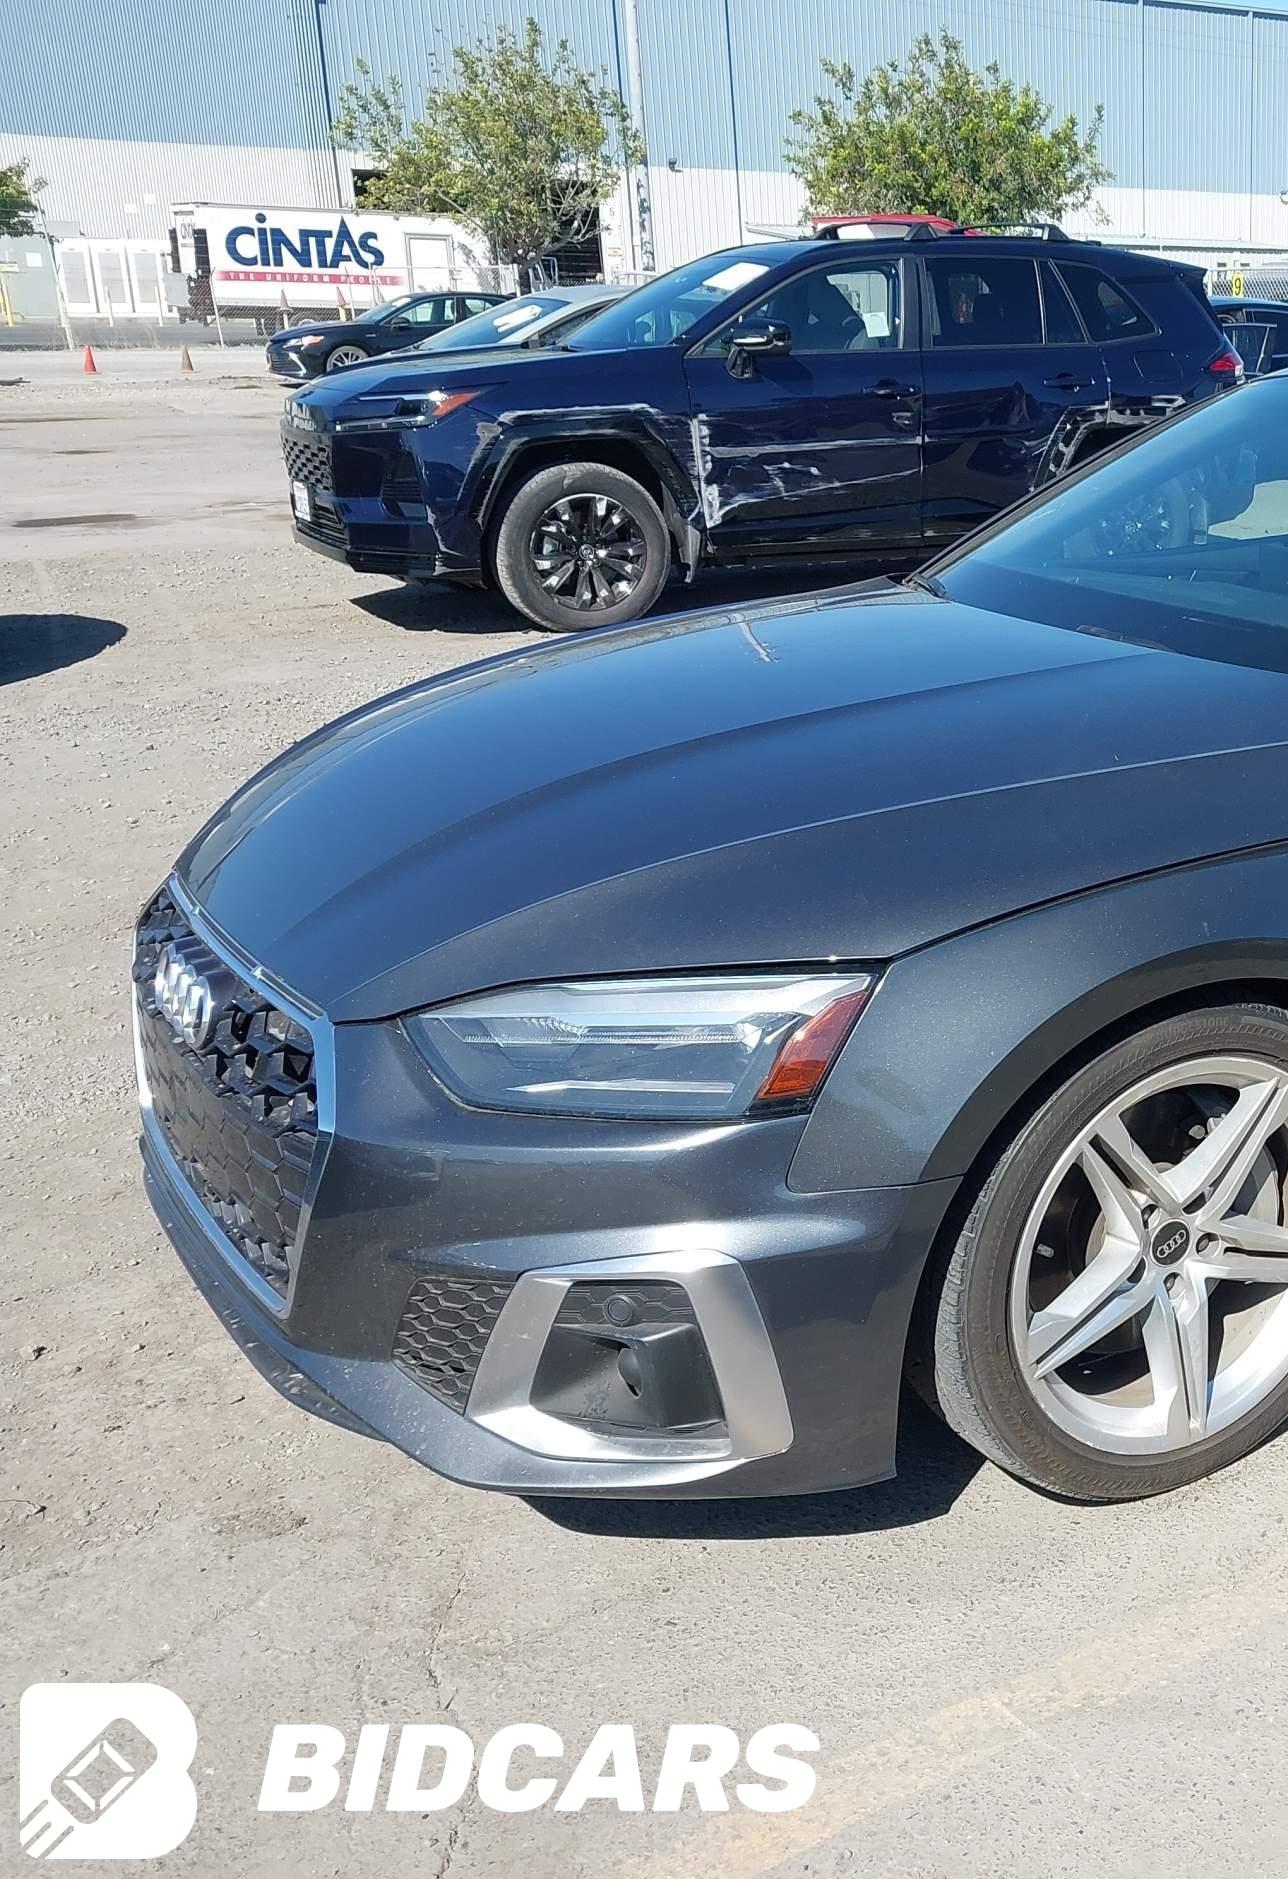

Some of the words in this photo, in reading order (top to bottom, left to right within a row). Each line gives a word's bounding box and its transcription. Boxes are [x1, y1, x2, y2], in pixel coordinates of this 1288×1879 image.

[229, 271, 255, 281] THE
[266, 273, 330, 283] UNIFORM
[1234, 277, 1242, 296] 9
